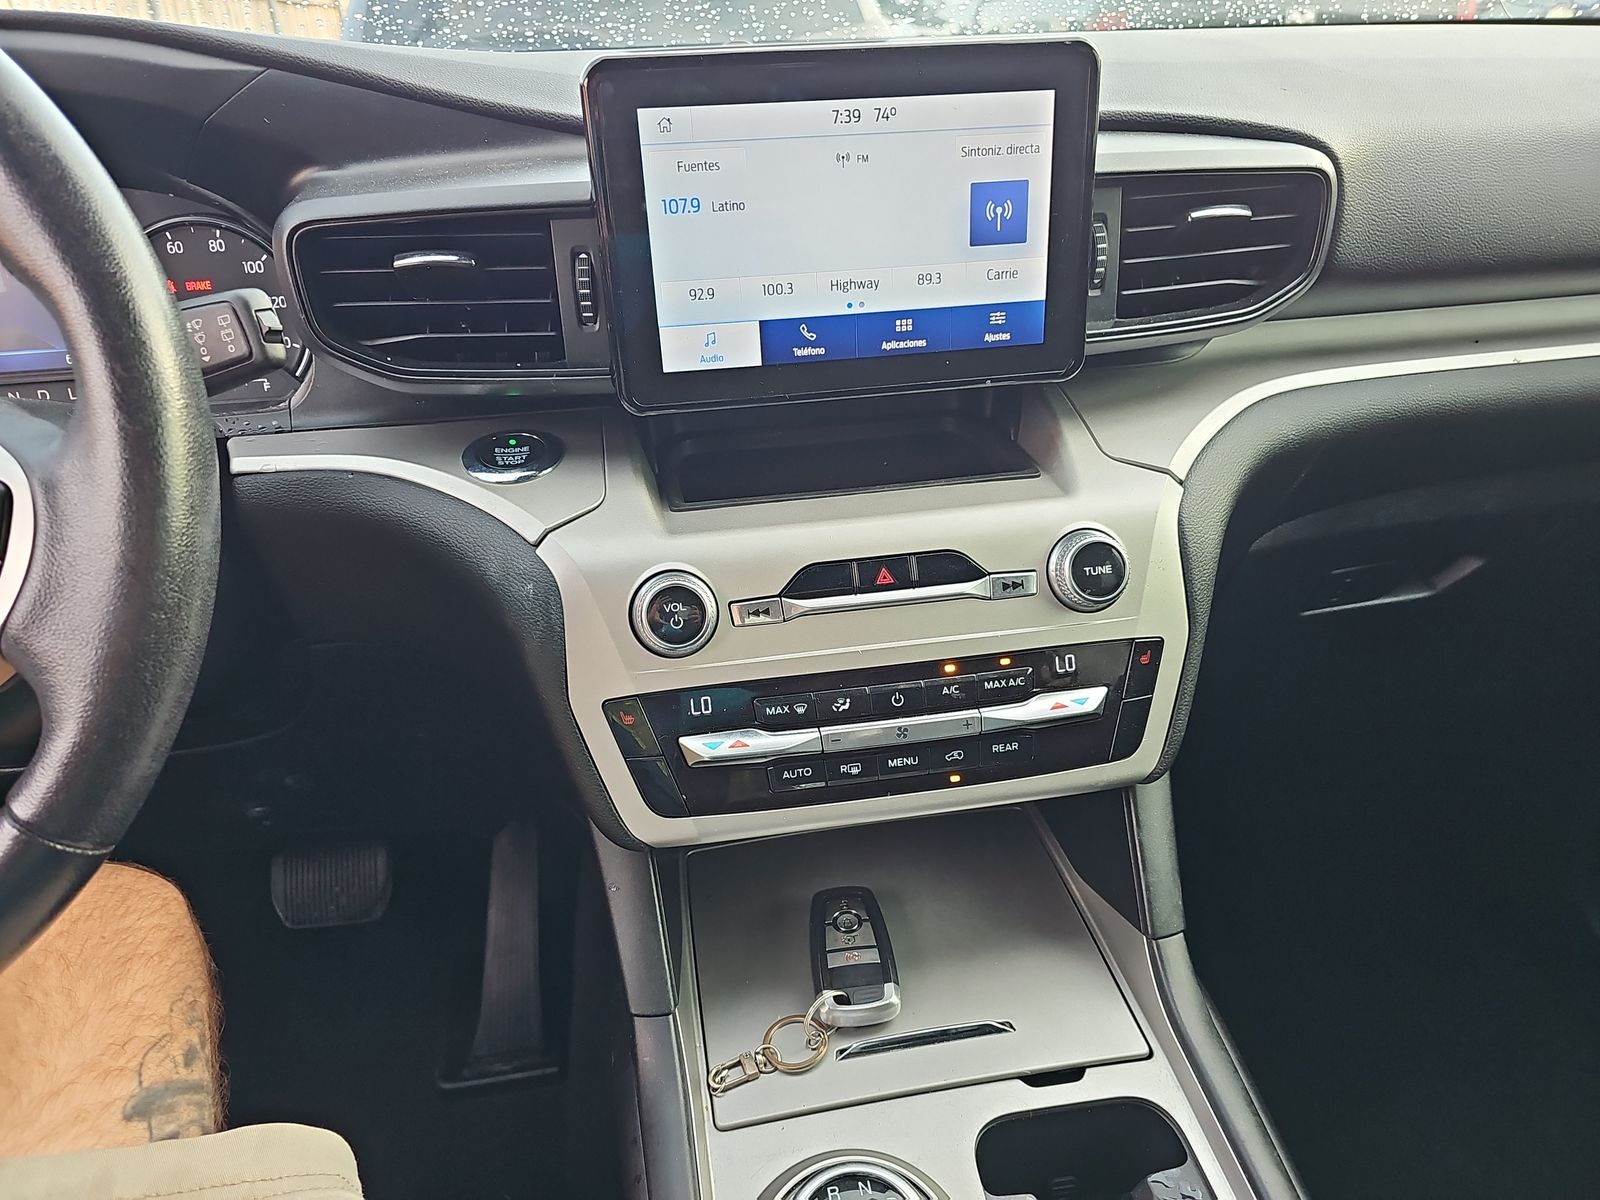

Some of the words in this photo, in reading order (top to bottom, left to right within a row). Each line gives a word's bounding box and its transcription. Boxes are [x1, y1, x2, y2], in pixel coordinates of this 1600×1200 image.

[831, 108, 862, 124] 7:39
[960, 145, 1004, 158] Sintoniz.
[1006, 143, 1040, 156] directa
[856, 154, 869, 164] FM
[676, 160, 720, 173] Fuentes
[661, 197, 701, 215] 107.9
[712, 200, 746, 214] Latino
[166, 241, 184, 254] 60
[208, 239, 226, 252] 80
[242, 260, 264, 274] 100
[917, 272, 942, 286] 89.3
[986, 267, 1019, 281] Carrie
[185, 280, 212, 292] BRAKE
[762, 282, 794, 296] 100.3
[830, 278, 880, 294] Highway
[688, 287, 715, 301] 92.9
[270, 296, 287, 308] 20
[984, 331, 1010, 342] Ajustes
[881, 338, 927, 350] Aplicaciones
[792, 346, 826, 357] Teléfono
[700, 354, 724, 363] Audio
[263, 382, 271, 392] F
[494, 446, 530, 454] ENGINE
[1084, 564, 1113, 576] TUNE
[663, 603, 687, 613] VOL
[1055, 654, 1076, 674] LO
[984, 679, 1007, 690] MAX
[1008, 676, 1026, 687] A/C
[942, 684, 960, 696] A/C
[690, 696, 712, 716] LO
[766, 704, 790, 716] MAX
[992, 742, 1020, 753] REAR
[888, 756, 919, 768] MENU
[782, 768, 812, 780] AUTO
[827, 1186, 840, 1200] R
[858, 1180, 872, 1196] N
